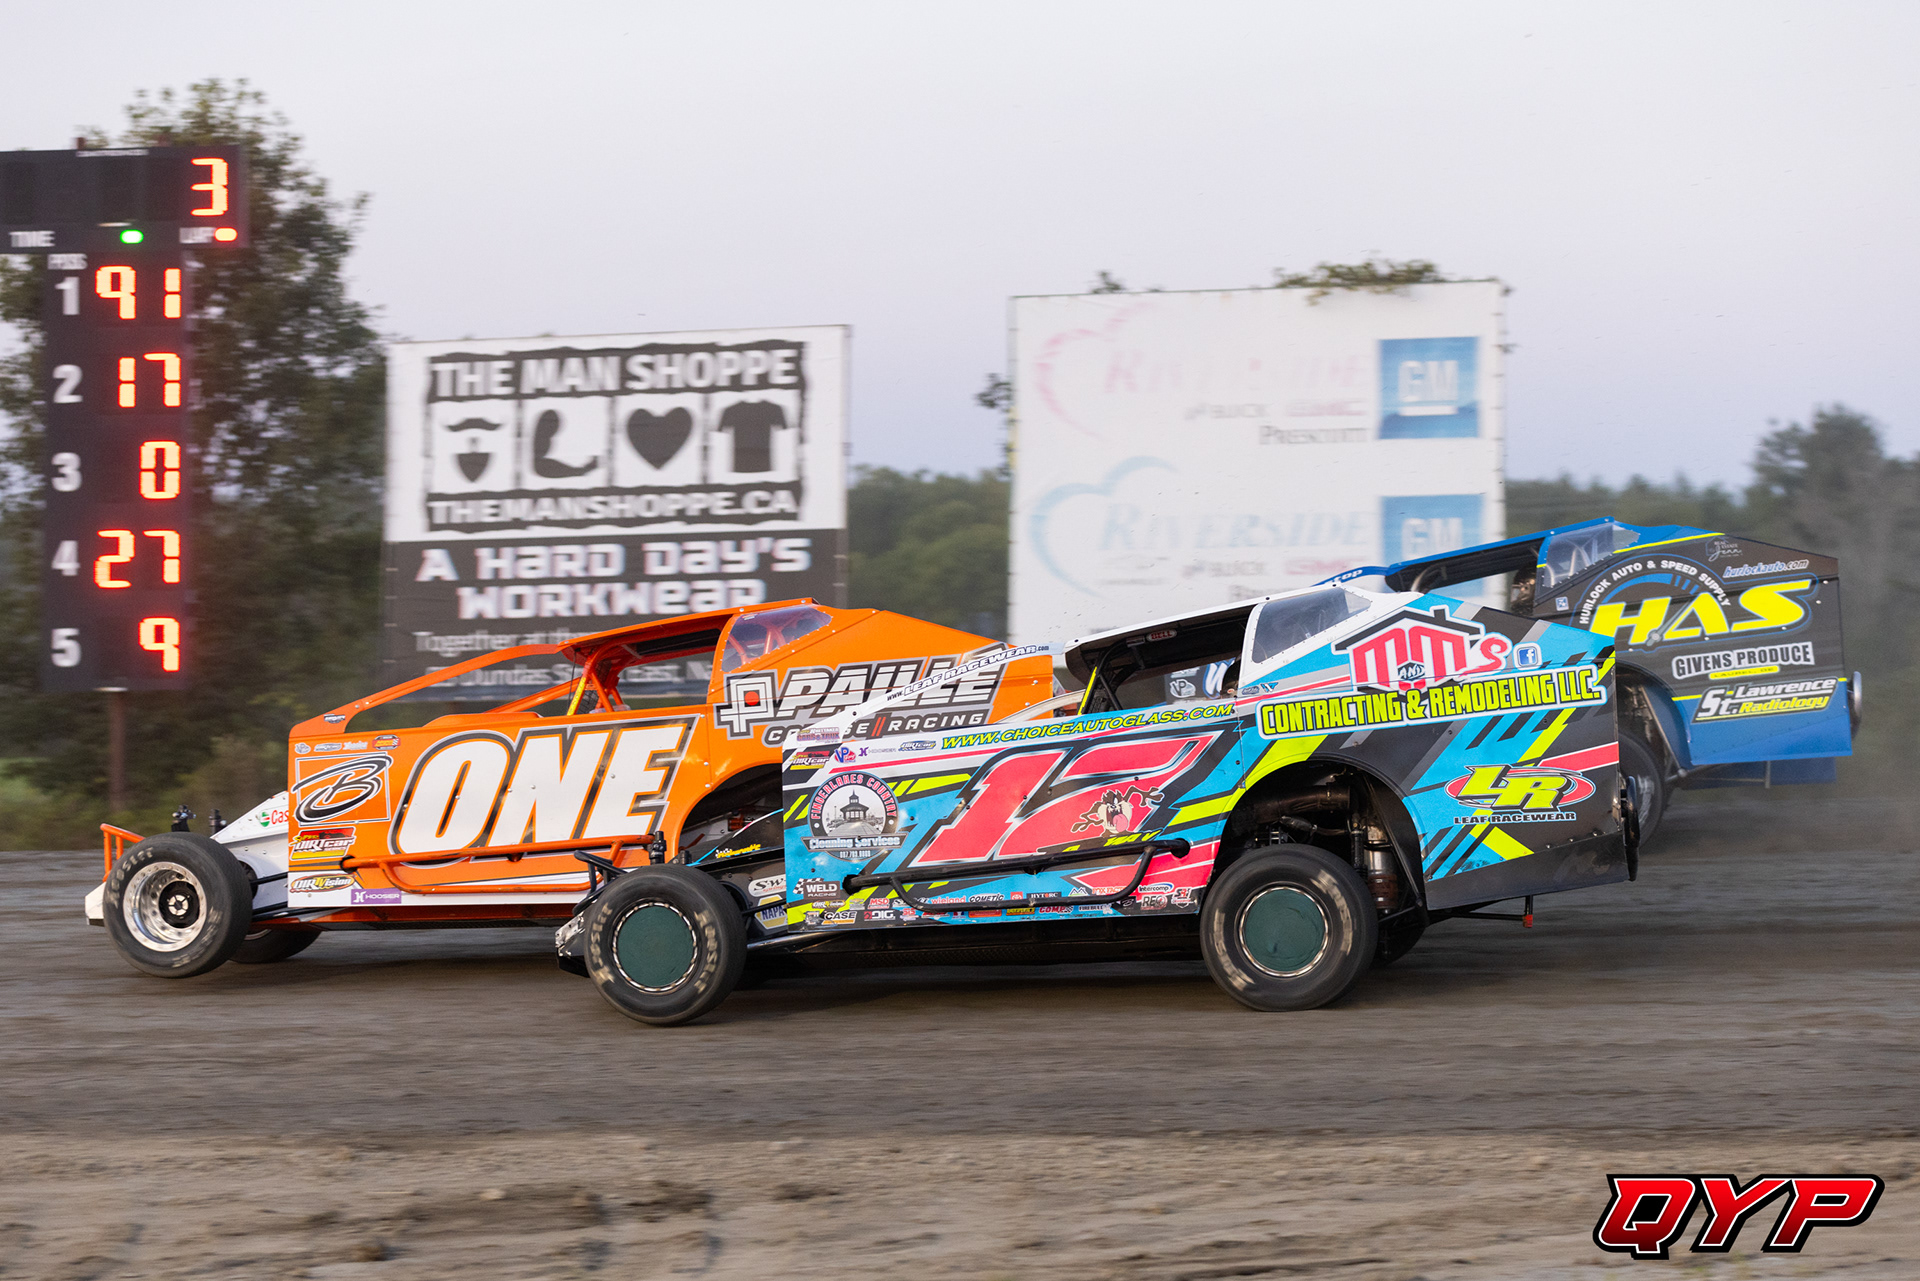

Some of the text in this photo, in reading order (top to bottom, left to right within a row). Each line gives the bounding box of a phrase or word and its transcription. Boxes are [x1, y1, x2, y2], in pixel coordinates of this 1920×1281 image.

[191, 157, 229, 216] 3
[55, 277, 80, 315] 1
[95, 265, 182, 320] 91
[52, 364, 83, 403] 2
[118, 352, 181, 407] 17
[431, 349, 799, 397] THE MAN SHOPPE
[1400, 358, 1460, 403] GM
[51, 452, 82, 492] 3
[140, 440, 181, 499] 0
[428, 489, 799, 525] THEMANSHOPPE.CA
[51, 540, 80, 576] 4
[94, 529, 180, 588] 27
[415, 548, 459, 582] A
[1723, 559, 1809, 578] hurlockauto.com
[1579, 560, 1731, 625] HURLOCK AUTO & SPEED SUPPLY
[1589, 579, 1812, 646] HAS
[51, 628, 82, 667] 5
[139, 617, 181, 672] 9
[1151, 631, 1172, 639] BELL
[1675, 644, 1811, 677] GIVENS PRODUCE
[1262, 670, 1602, 735] CONTRACTING & REMODELING LLC.
[1735, 678, 1837, 698] Lawrence
[1739, 696, 1830, 714] Radiology
[888, 711, 985, 732] RACING
[942, 703, 1235, 749] WWW.CHOICEAUTOGLASS.COM
[391, 719, 694, 857] ONE
[911, 731, 1218, 867] 17
[1458, 766, 1572, 812] LR
[1454, 812, 1576, 825] LEAF RACEWEAR
[809, 836, 900, 849] Cleaning Services
[806, 884, 837, 892] WELD
[931, 896, 966, 904] wieland
[762, 905, 785, 920] NAPA
